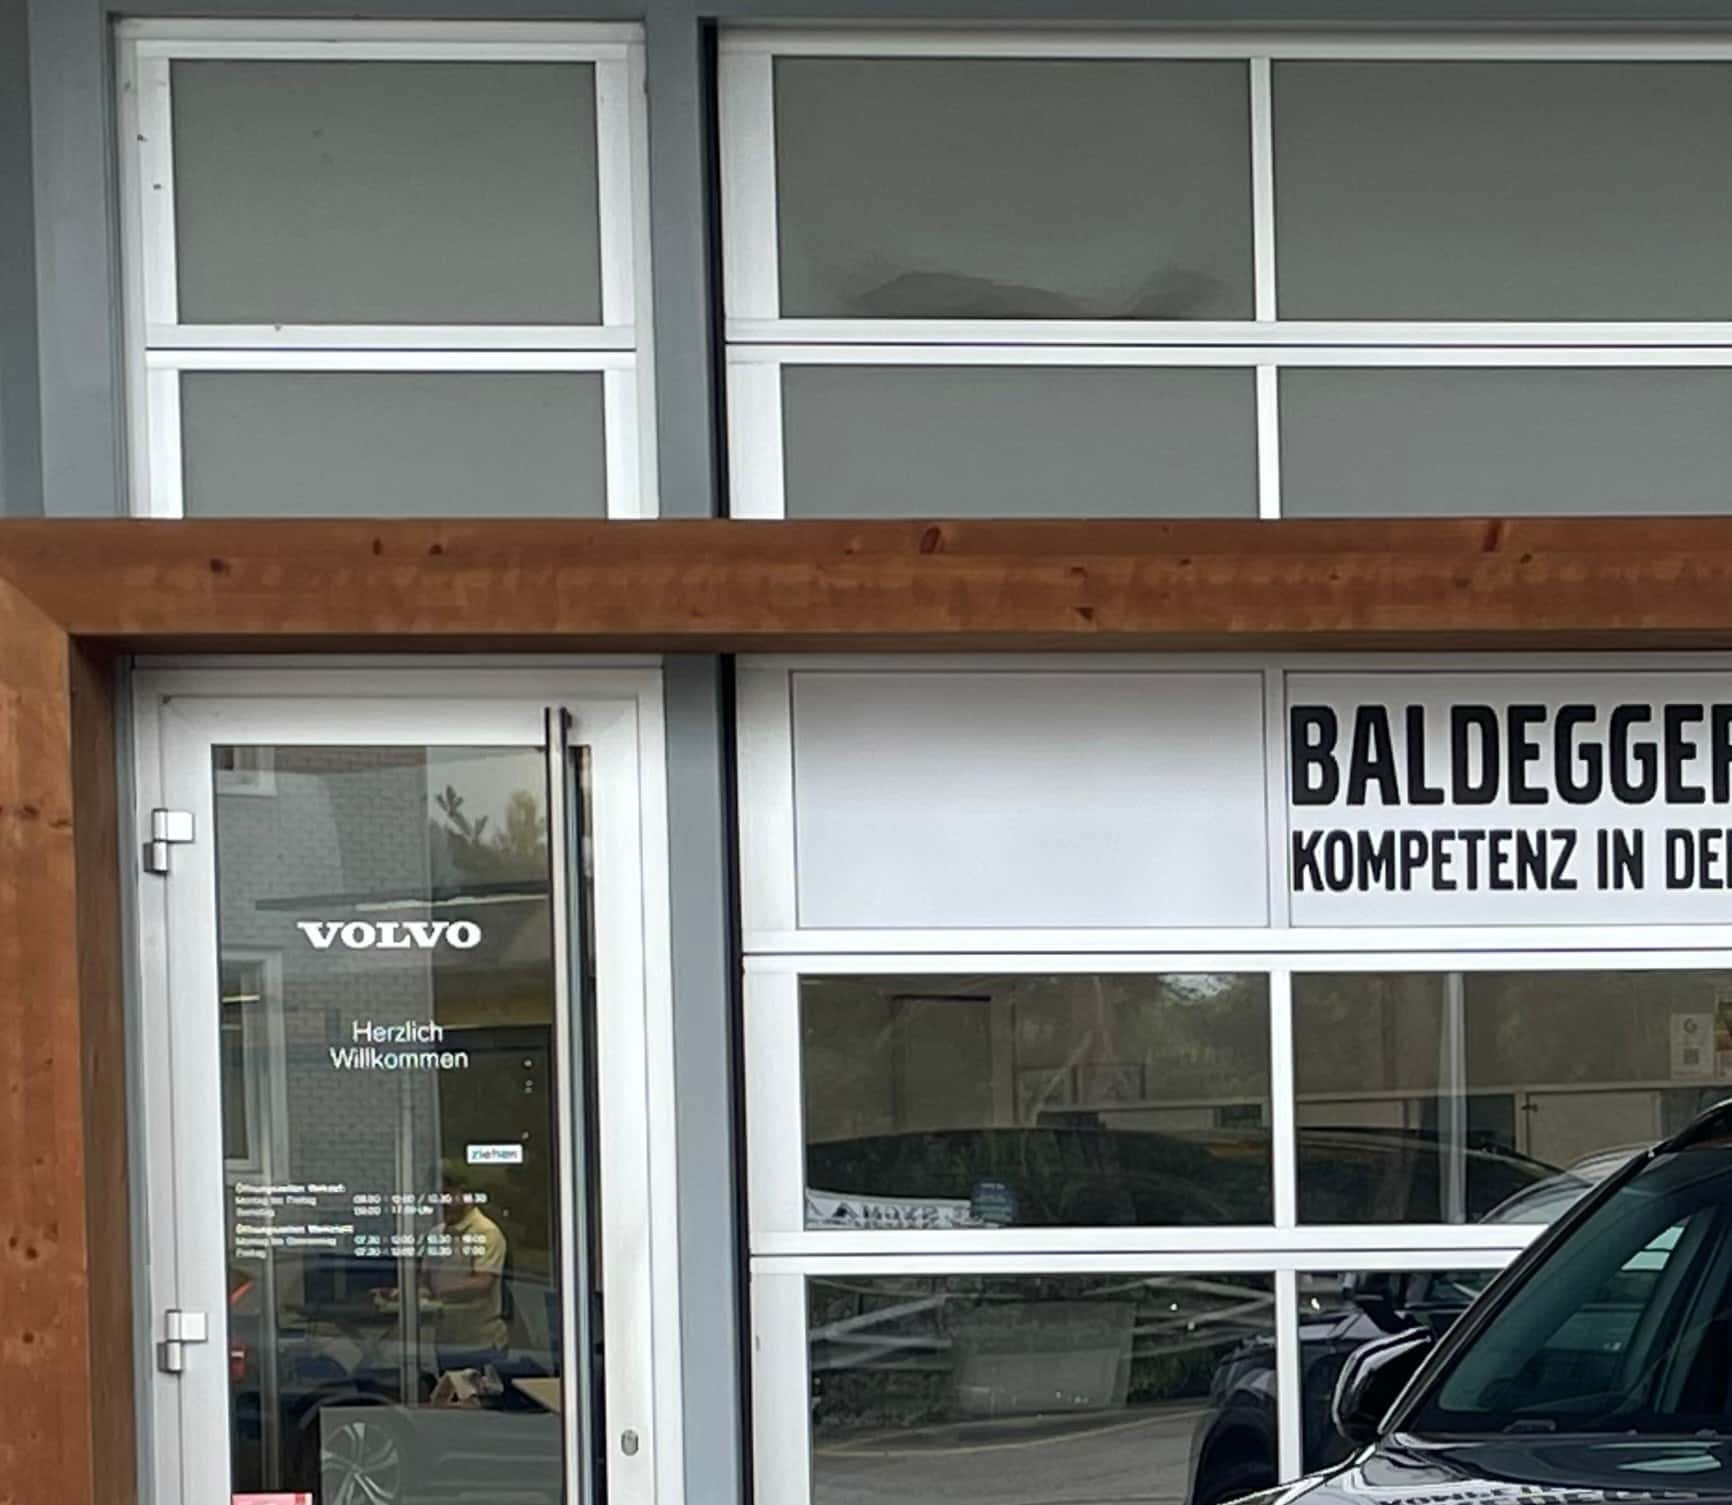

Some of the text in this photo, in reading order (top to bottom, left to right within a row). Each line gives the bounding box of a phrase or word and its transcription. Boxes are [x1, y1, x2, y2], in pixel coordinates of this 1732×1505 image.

[1292, 829, 1578, 891] KOMPETENZ
[1597, 828, 1644, 890] IN
[296, 921, 482, 950] VOLVO
[351, 1019, 444, 1043] Herzlich
[329, 1047, 469, 1070] Willkommen
[471, 1147, 518, 1160] ziehen
